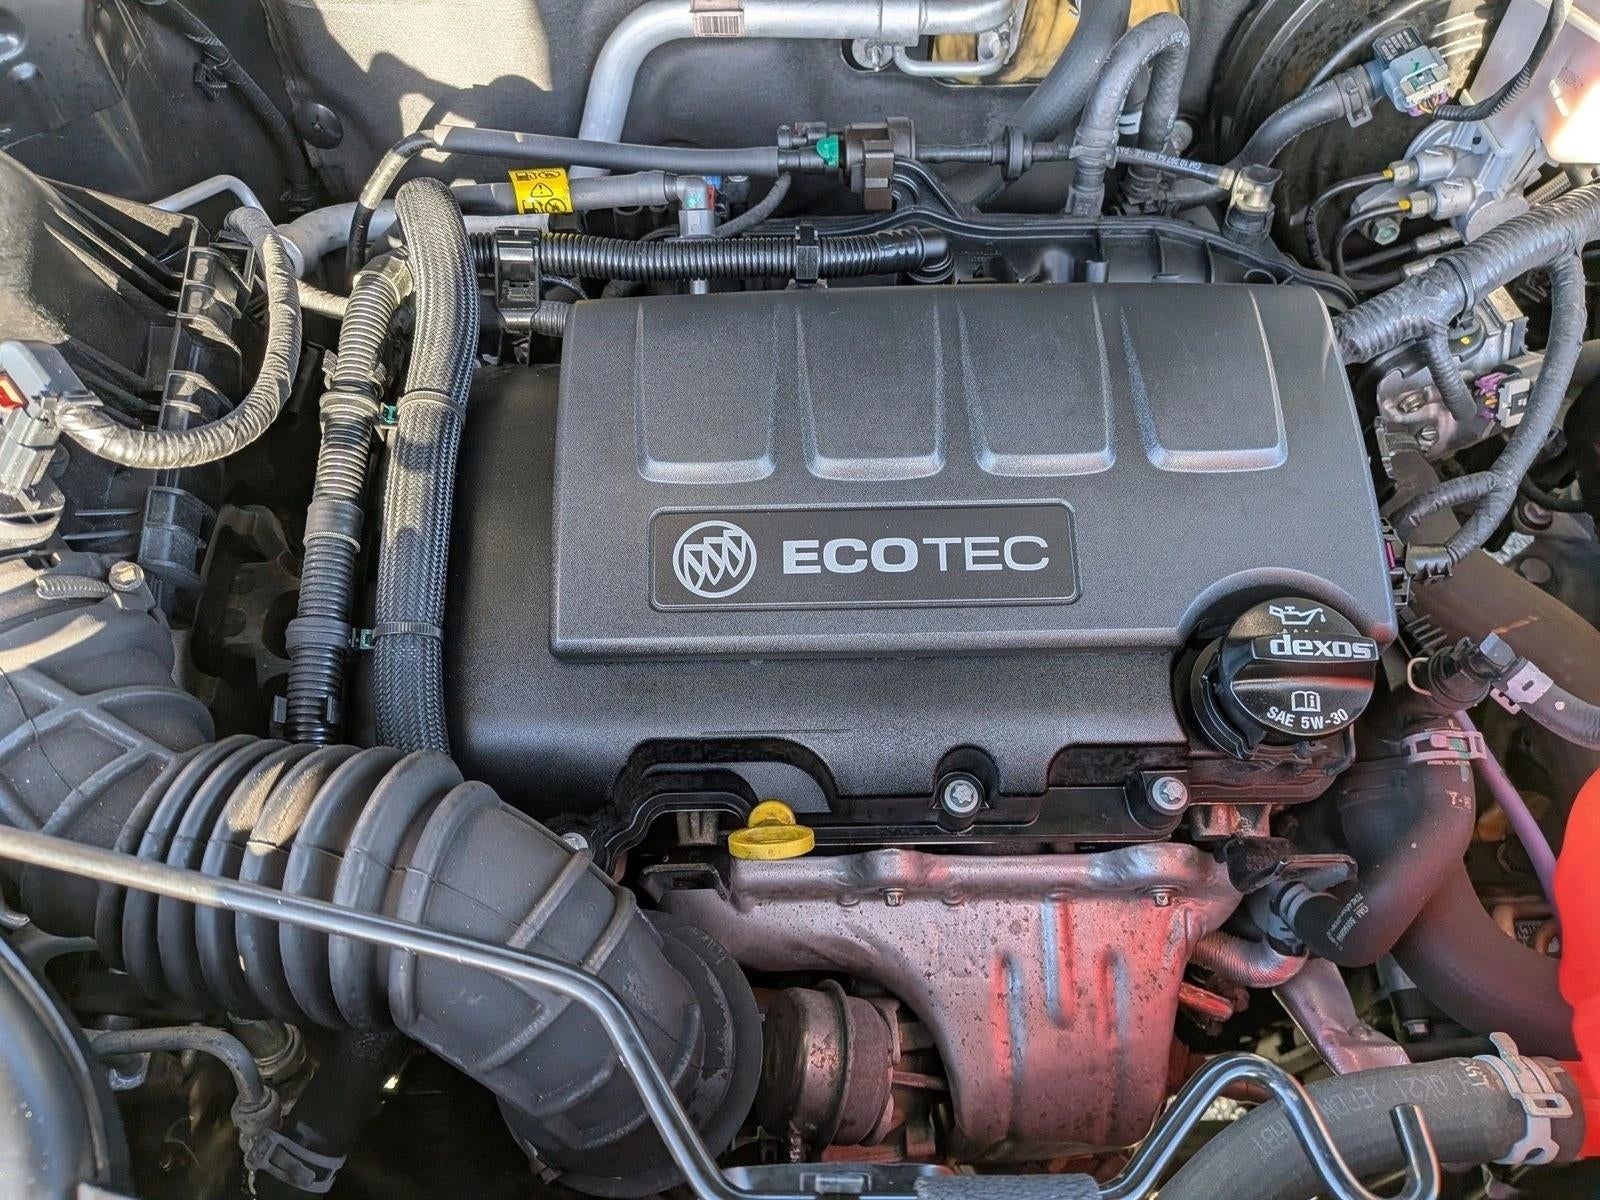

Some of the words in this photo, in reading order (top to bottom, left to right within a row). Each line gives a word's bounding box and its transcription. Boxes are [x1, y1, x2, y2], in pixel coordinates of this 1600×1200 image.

[783, 536, 1050, 575] ECOTEC
[1270, 634, 1374, 659] dexos
[1267, 706, 1296, 727] SAE
[1301, 708, 1349, 730] 5W-30
